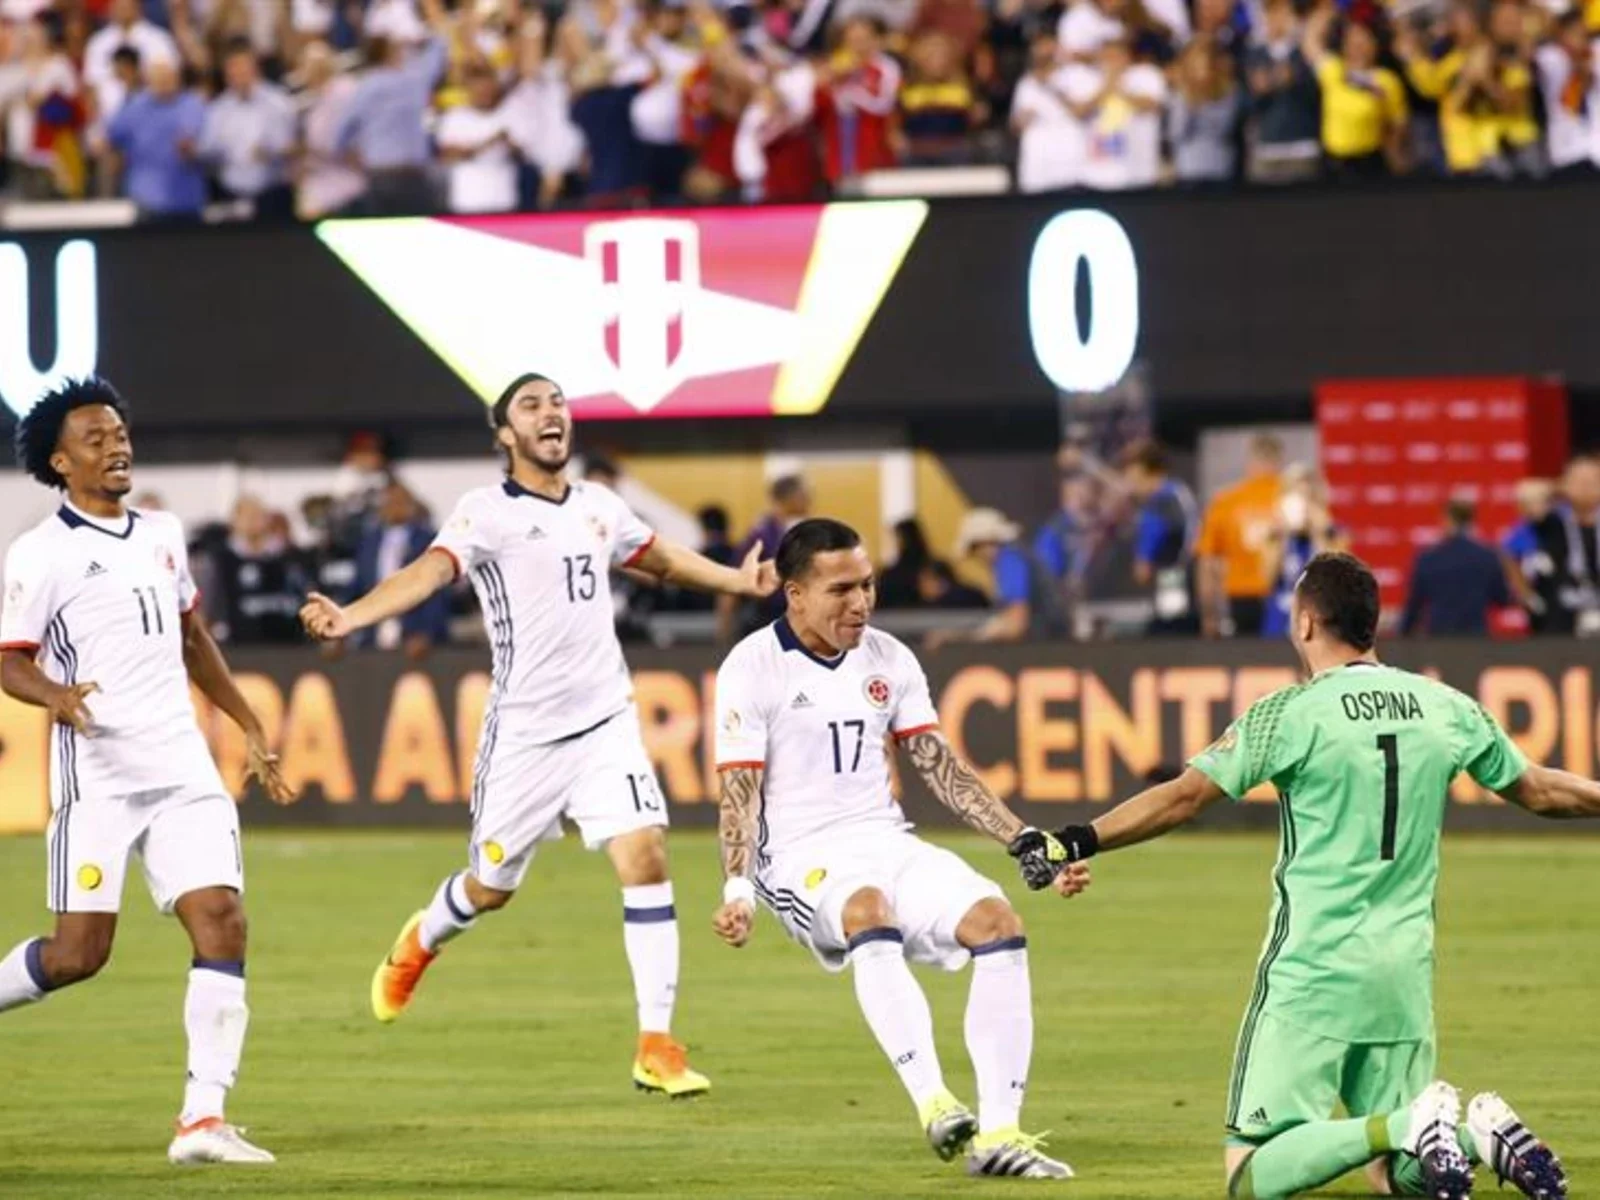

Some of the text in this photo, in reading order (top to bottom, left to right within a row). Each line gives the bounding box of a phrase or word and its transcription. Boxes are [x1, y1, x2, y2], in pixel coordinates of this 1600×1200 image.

[562, 554, 596, 603] 13
[132, 586, 163, 635] 11
[1341, 691, 1424, 721] OSPINA
[828, 719, 864, 773] 17
[626, 773, 660, 813] 13
[1376, 734, 1399, 861] 1
